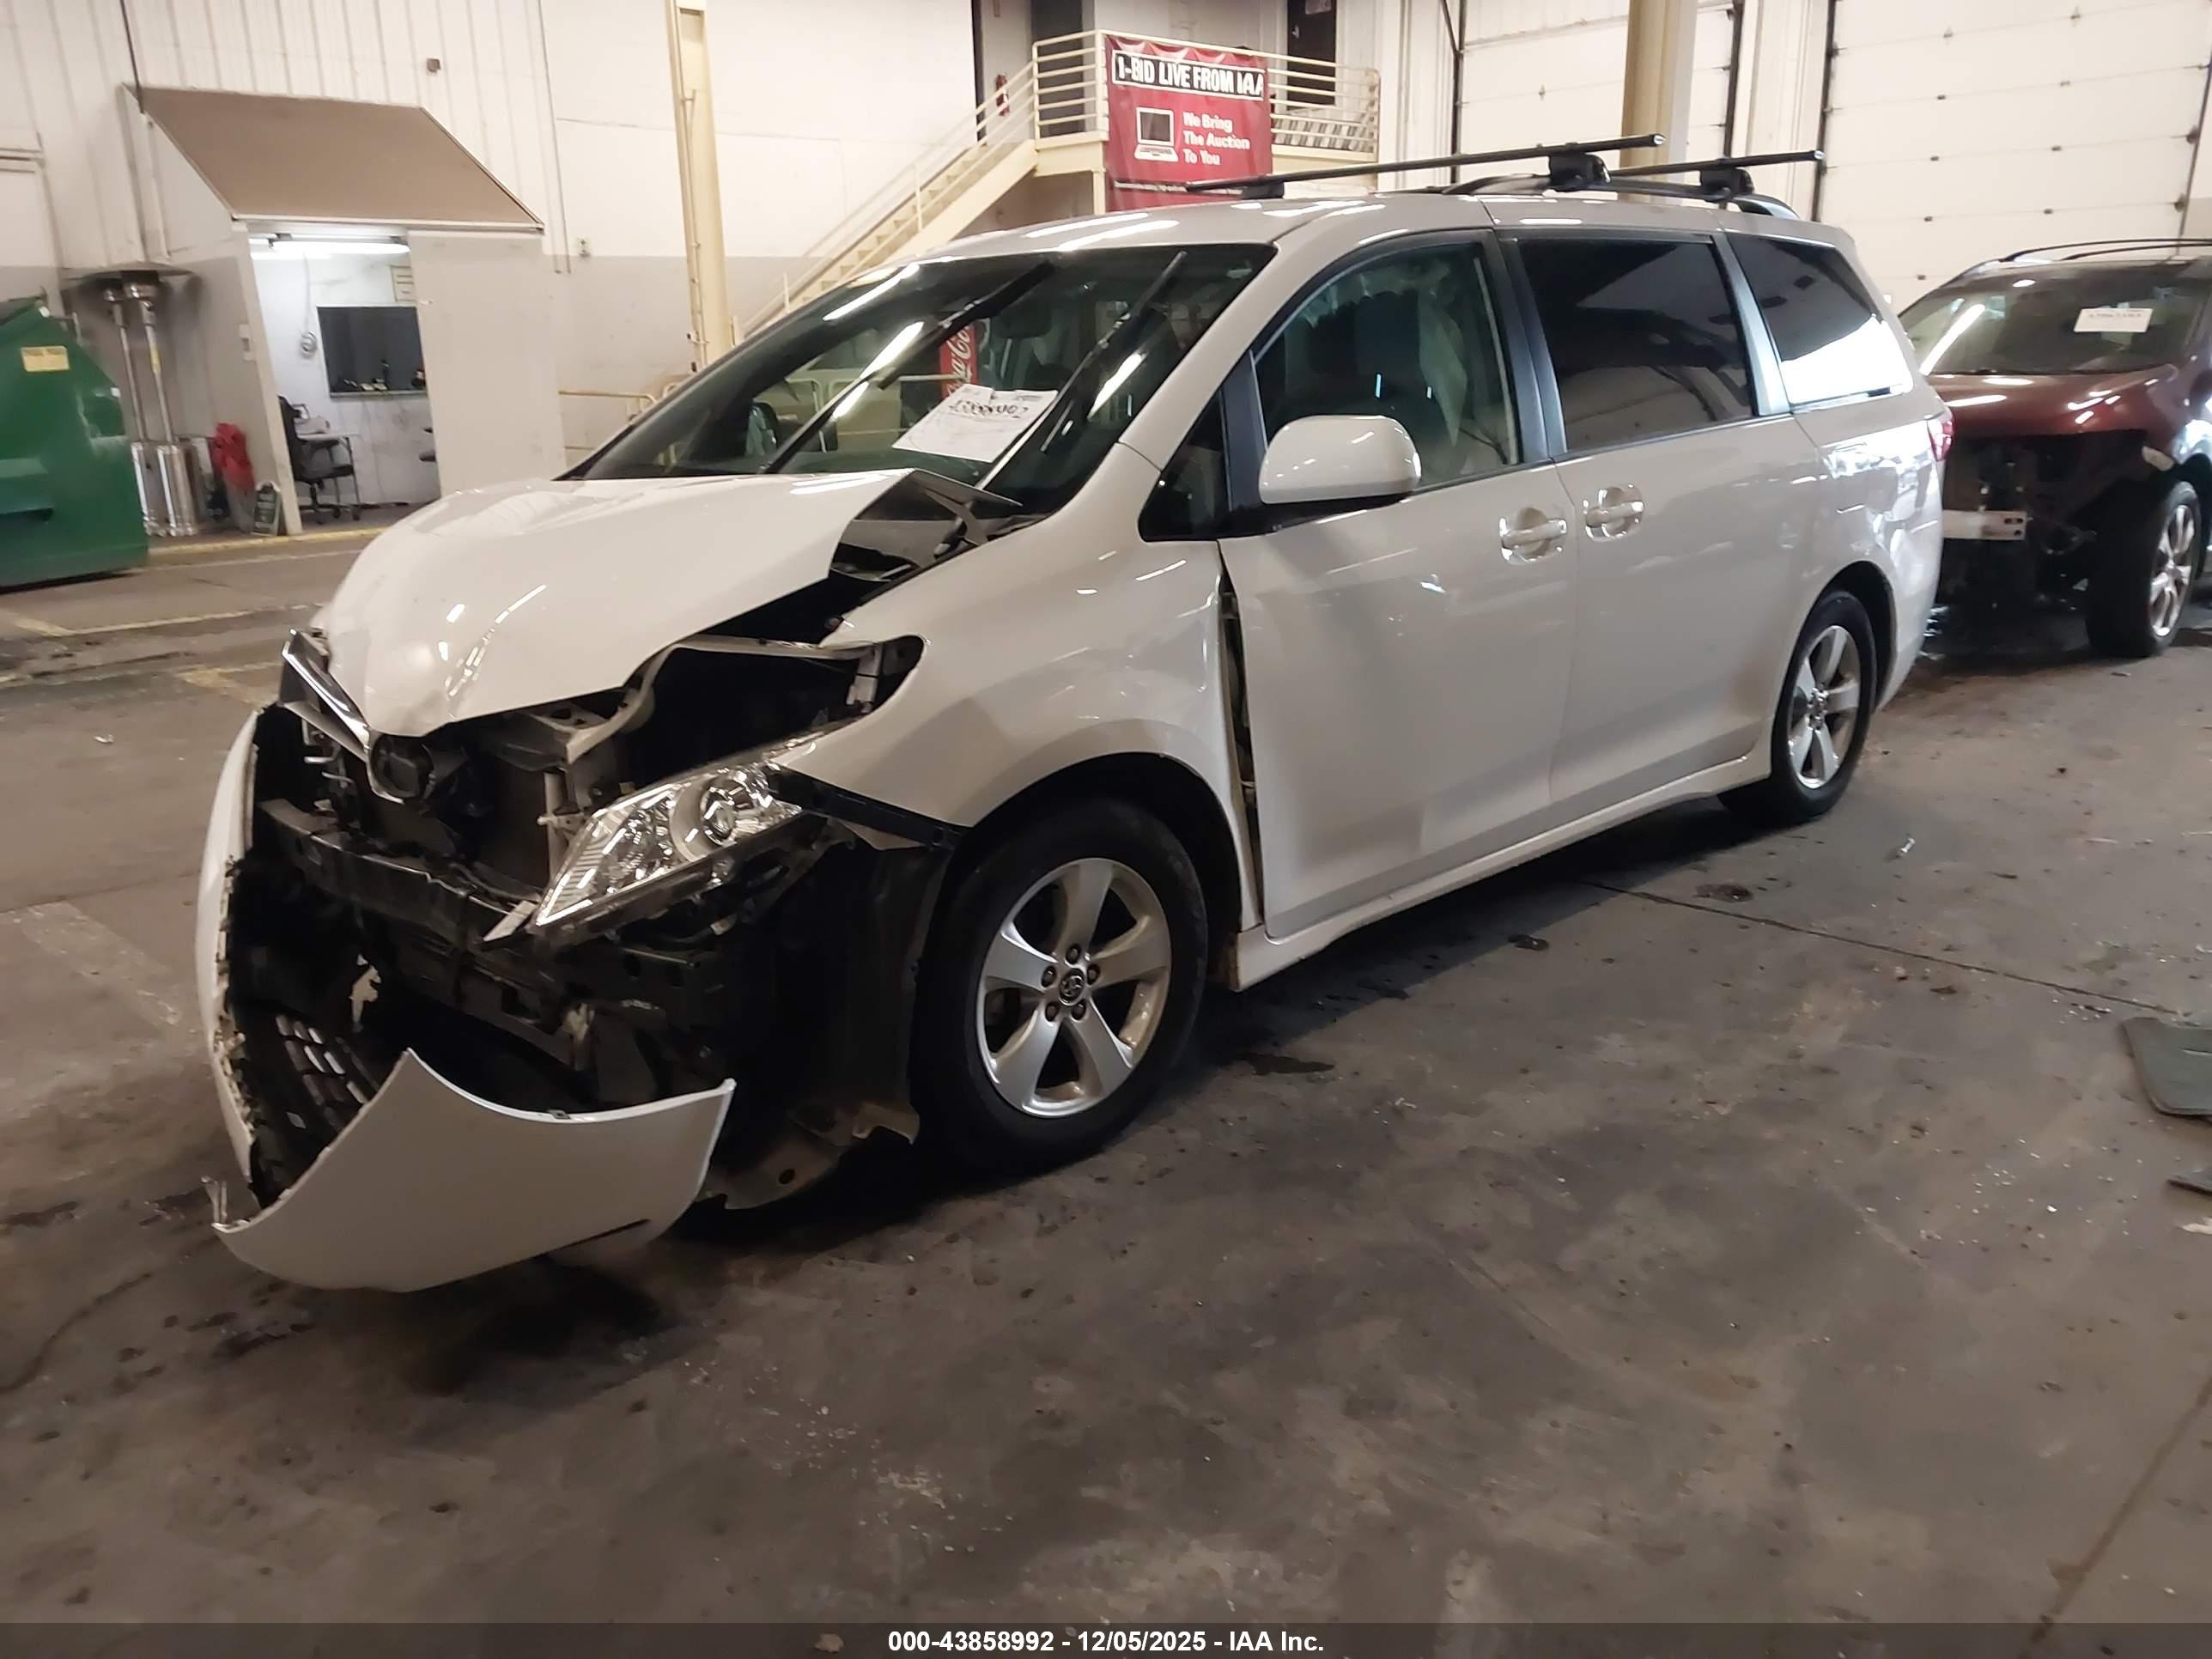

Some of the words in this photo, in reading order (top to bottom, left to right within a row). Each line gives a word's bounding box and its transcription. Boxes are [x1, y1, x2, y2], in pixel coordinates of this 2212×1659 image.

[1159, 62, 1192, 88] LIVE
[1193, 66, 1234, 93] FROM
[1182, 112, 1200, 127] We
[1201, 113, 1233, 133] Bring
[1183, 131, 1204, 146] The
[1206, 132, 1251, 149] Auction
[1182, 149, 1198, 164] To
[1200, 149, 1220, 165] You
